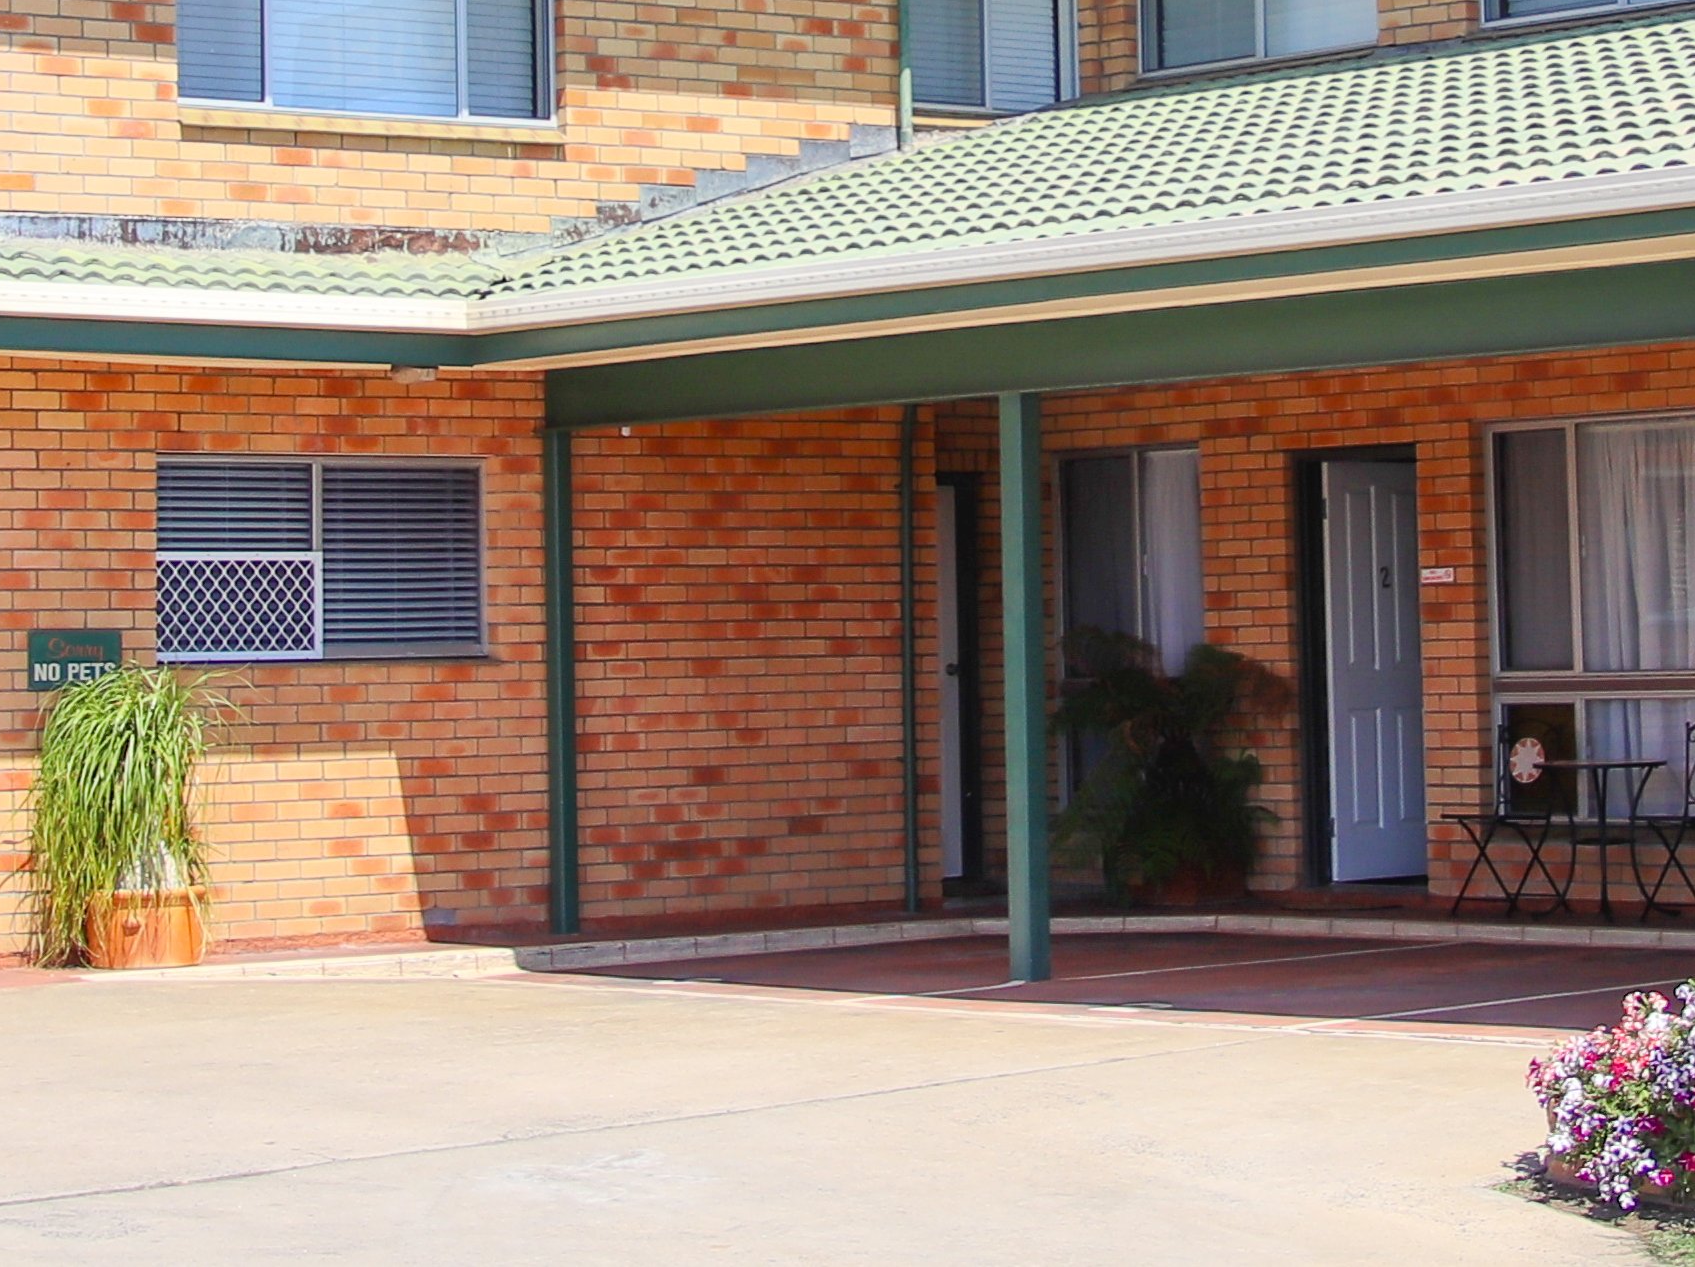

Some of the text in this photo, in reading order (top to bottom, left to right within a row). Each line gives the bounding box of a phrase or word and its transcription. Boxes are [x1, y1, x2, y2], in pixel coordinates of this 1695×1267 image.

[1380, 566, 1391, 588] 2
[33, 662, 117, 683] NO PETS
